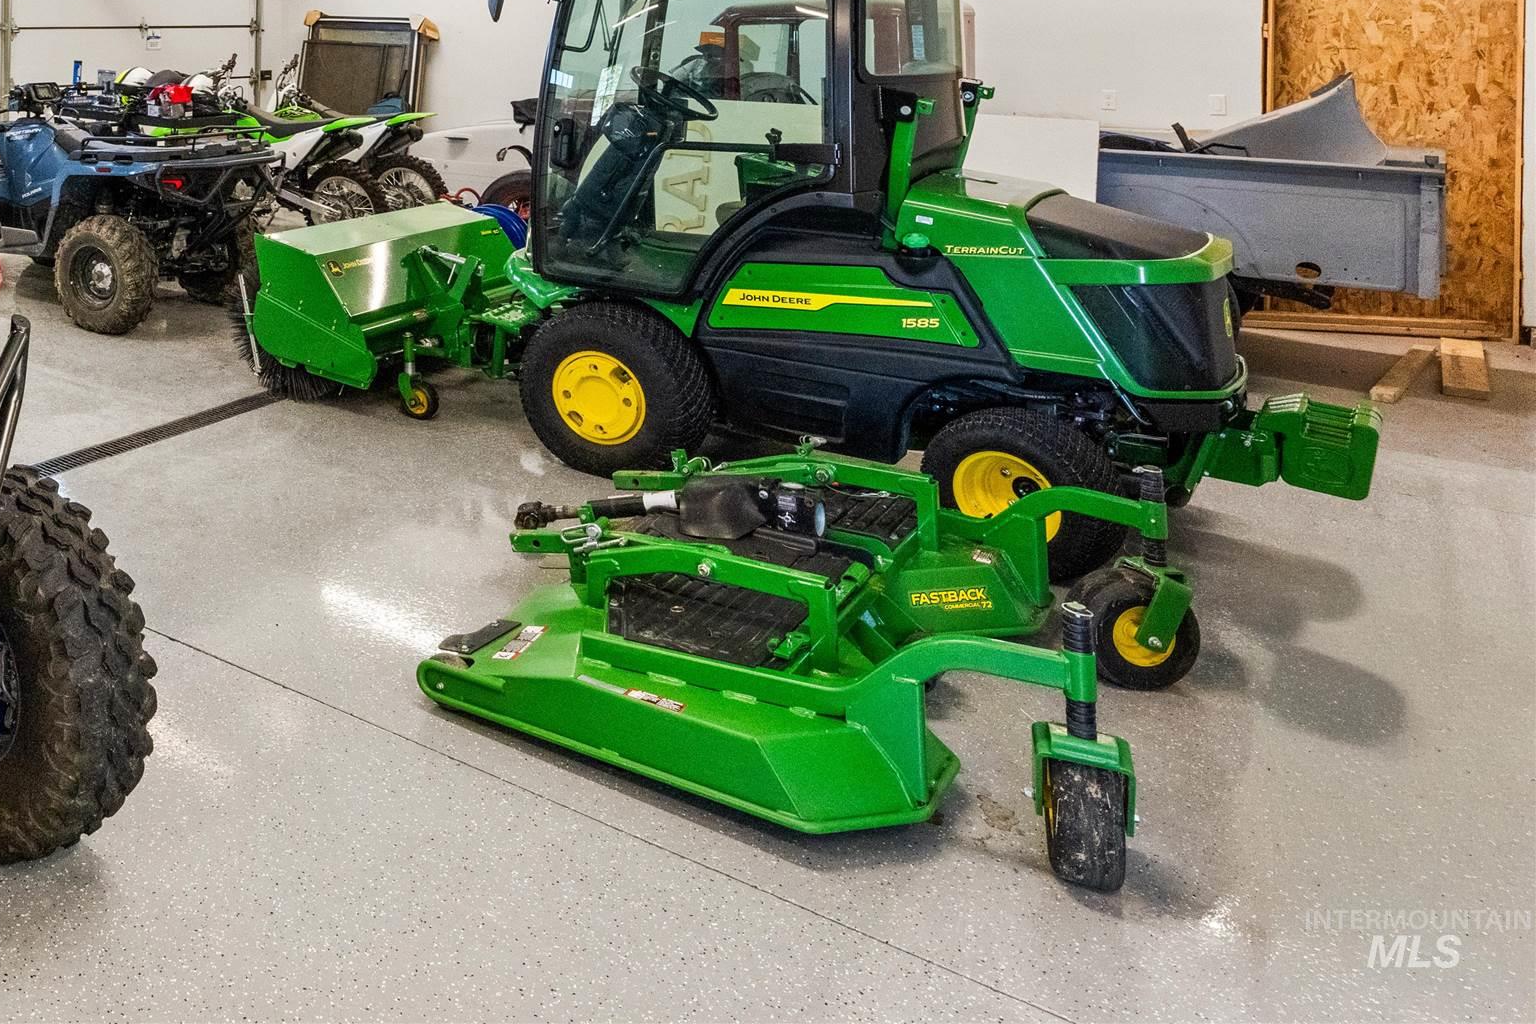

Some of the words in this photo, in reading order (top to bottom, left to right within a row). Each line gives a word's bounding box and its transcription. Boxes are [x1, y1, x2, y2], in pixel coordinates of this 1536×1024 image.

[944, 244, 1025, 256] TERRAINCUT
[738, 292, 770, 303] JOHN
[771, 295, 812, 306] DEERE
[900, 317, 941, 329] 1585
[910, 587, 987, 606] FASTBACK
[943, 602, 980, 610] COMMERCIAL
[980, 601, 993, 609] 72
